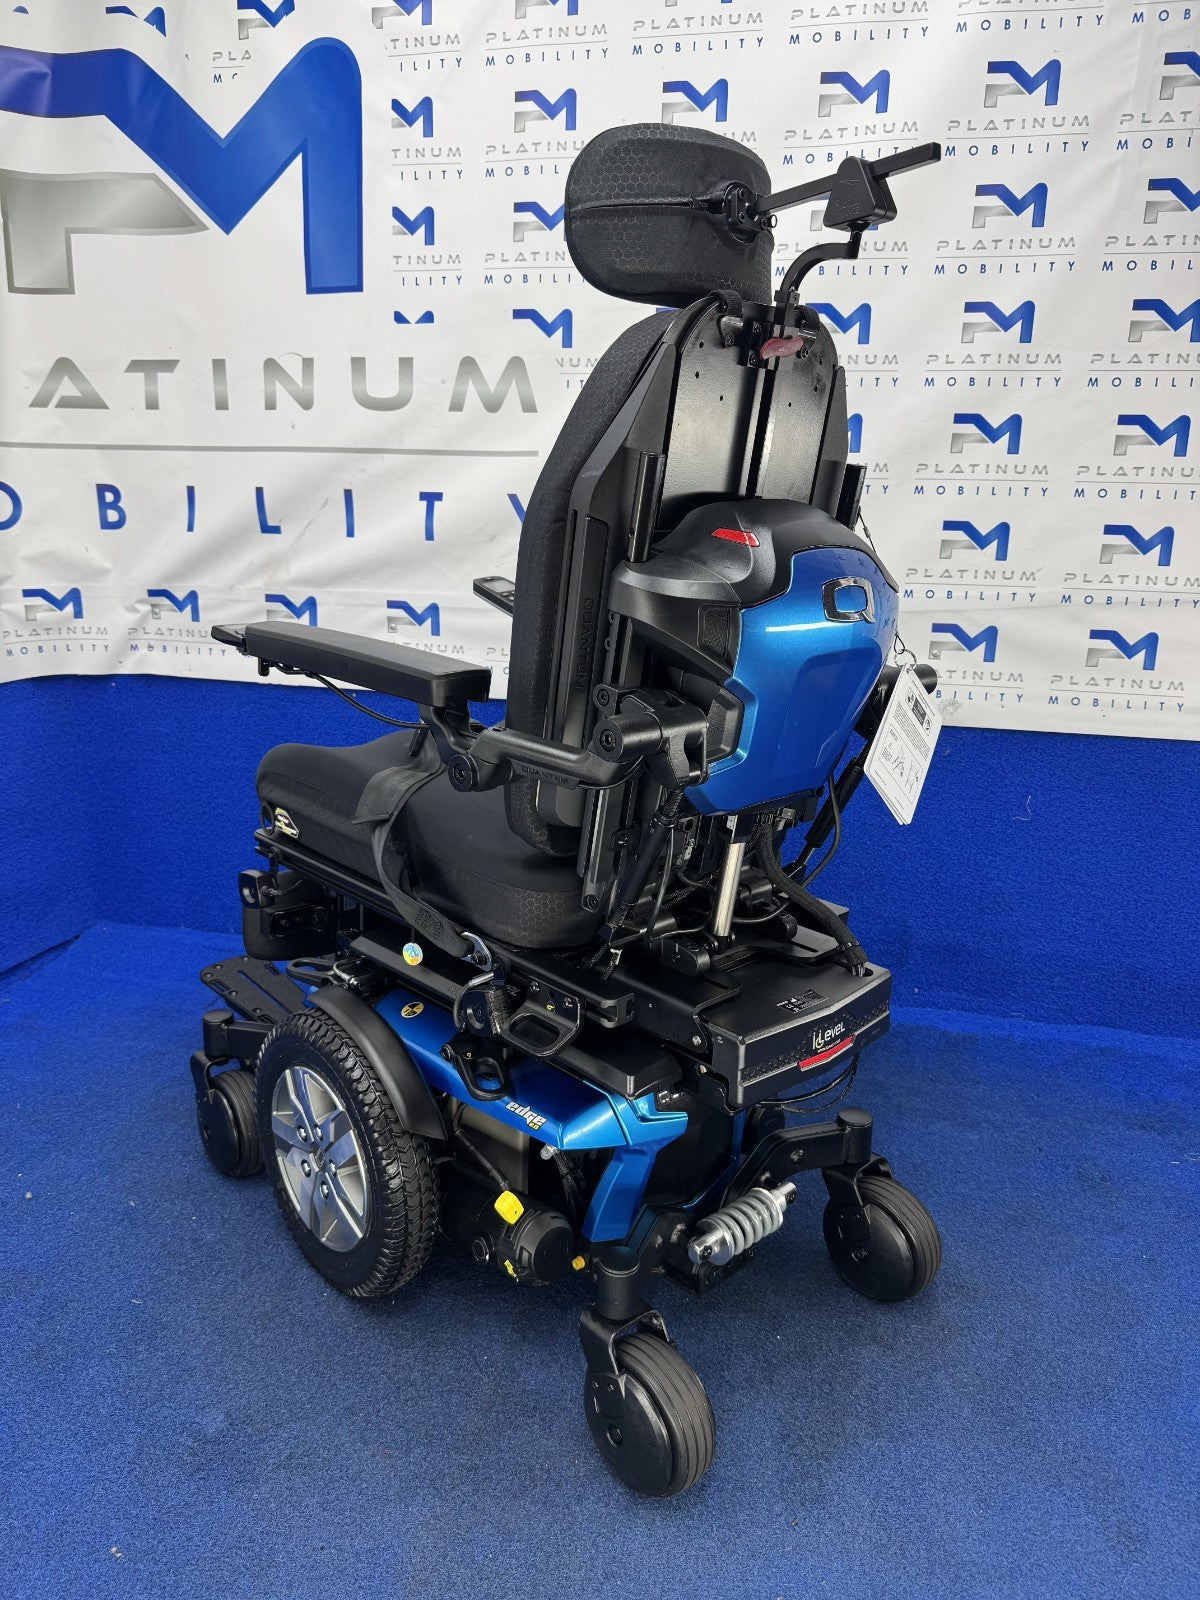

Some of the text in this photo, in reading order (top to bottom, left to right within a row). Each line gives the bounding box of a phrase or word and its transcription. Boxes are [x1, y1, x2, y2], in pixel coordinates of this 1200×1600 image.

[791, 1, 928, 20] PLATINUM
[634, 13, 762, 31] PLATINUM
[956, 14, 1104, 33] MOBILITY
[486, 24, 607, 43] PLATINUM
[789, 26, 928, 44] MOBILITY
[385, 34, 460, 50] TINUM
[632, 37, 763, 55] MOBILITY
[486, 48, 608, 66] MOBILITY
[948, 115, 1089, 131] PLATINUM
[1120, 111, 1200, 125] PLAT
[785, 121, 918, 140] PLATINUM
[783, 146, 915, 165] MOBILIT
[945, 141, 1089, 156] MOBILITY
[937, 237, 1075, 251] PLATINUM
[775, 265, 908, 276] MBILITY
[934, 261, 1075, 274] MOBILITY
[484, 273, 584, 284] MOBILI
[927, 354, 1061, 364] PLATINUM
[924, 377, 1061, 387] MOBILITY
[916, 463, 1048, 475] PLATINUM
[1077, 465, 1200, 478] PLATINU
[914, 486, 1048, 497] MOBILITY
[906, 568, 1036, 581] PLATINUM
[1064, 573, 1200, 587] PLATINUM
[903, 589, 1036, 602] MOBILITY
[1060, 594, 1199, 608] MOBILITY
[3, 626, 108, 639] PLATINUM
[6, 644, 109, 657] MOBILITY
[130, 643, 227, 656] MOBILITY
[1051, 675, 1184, 691] PLATINUM
[1048, 696, 1184, 712] MOBILITY
[505, 1101, 548, 1125] edge
